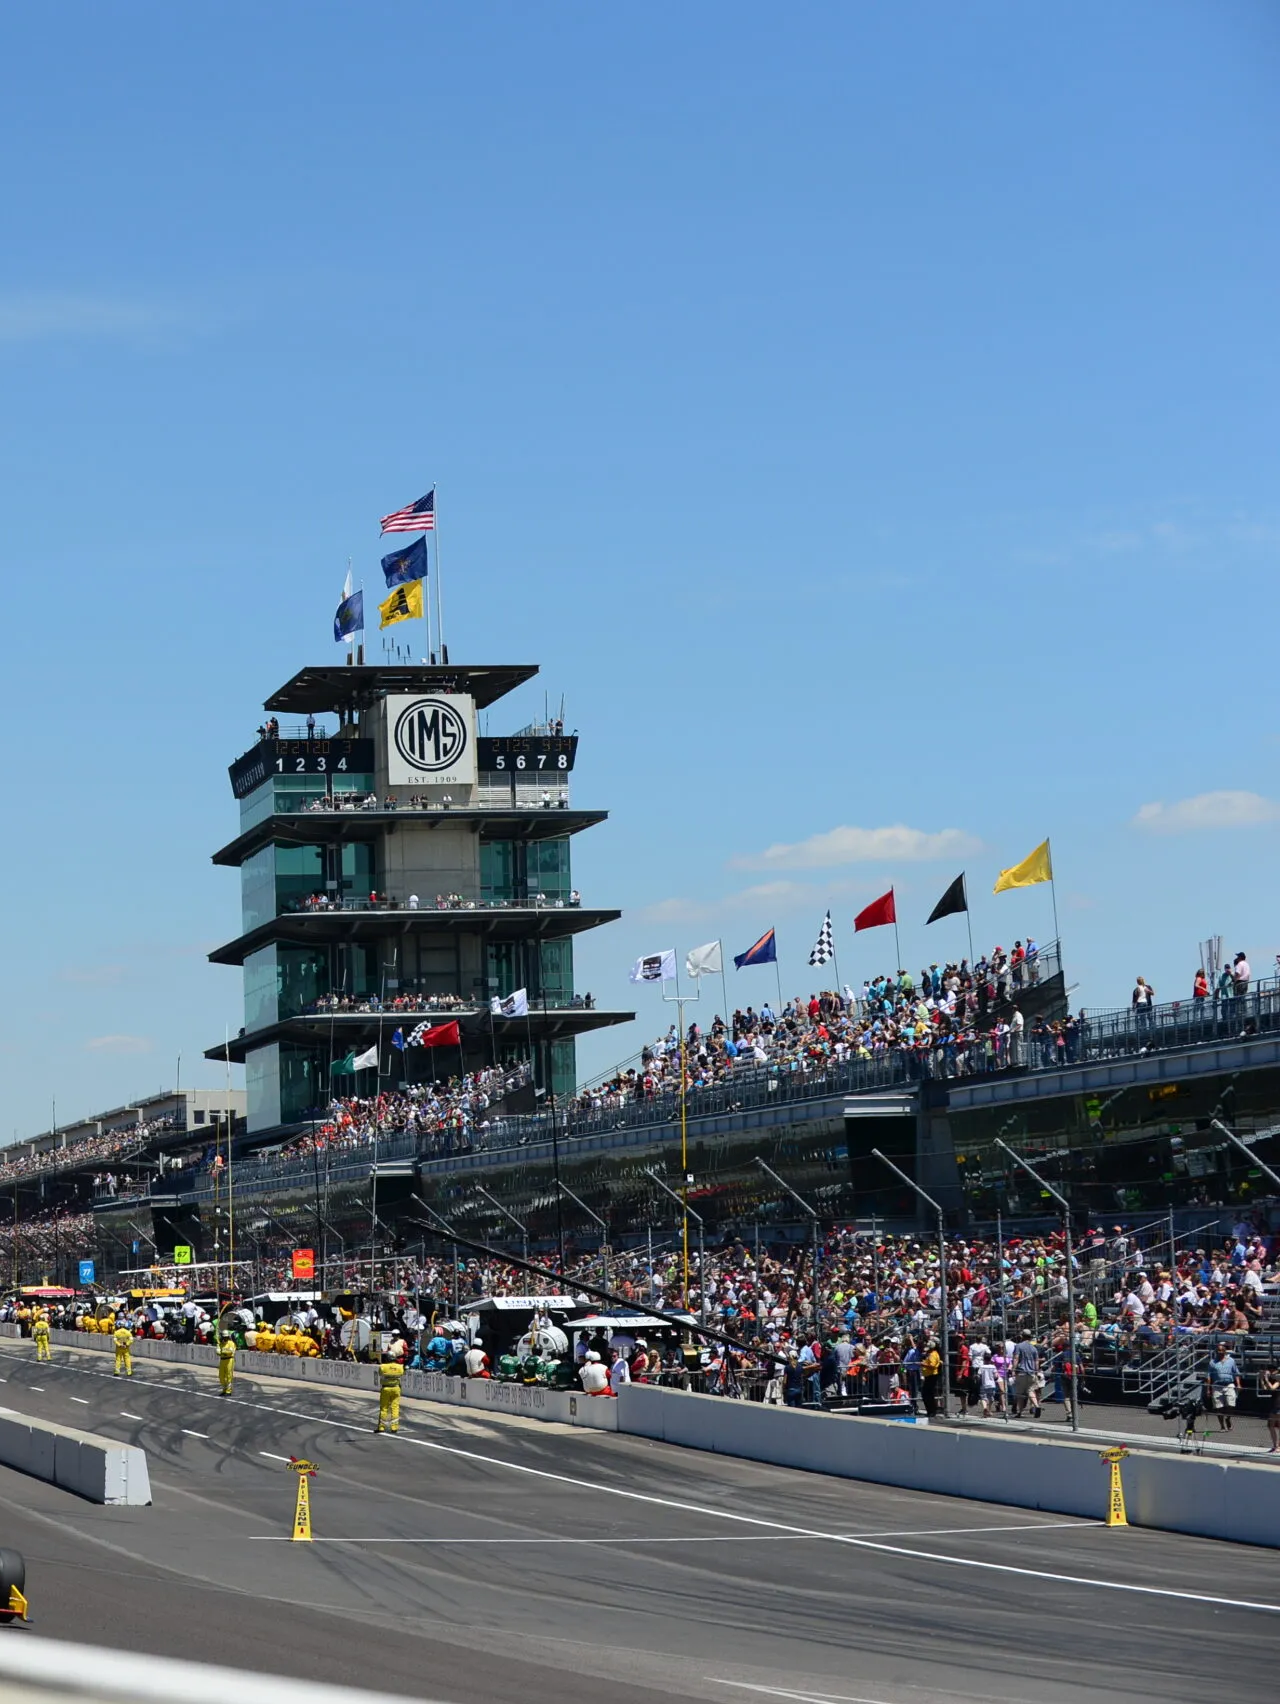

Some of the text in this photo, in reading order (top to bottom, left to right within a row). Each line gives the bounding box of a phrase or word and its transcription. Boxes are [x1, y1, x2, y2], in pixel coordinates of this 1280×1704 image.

[408, 709, 456, 761] IMS
[276, 757, 347, 772] 1 2 3 4
[496, 755, 567, 769] 5 6 7 8
[408, 776, 457, 784] EST. 1909
[288, 1463, 319, 1471] SUNOCO
